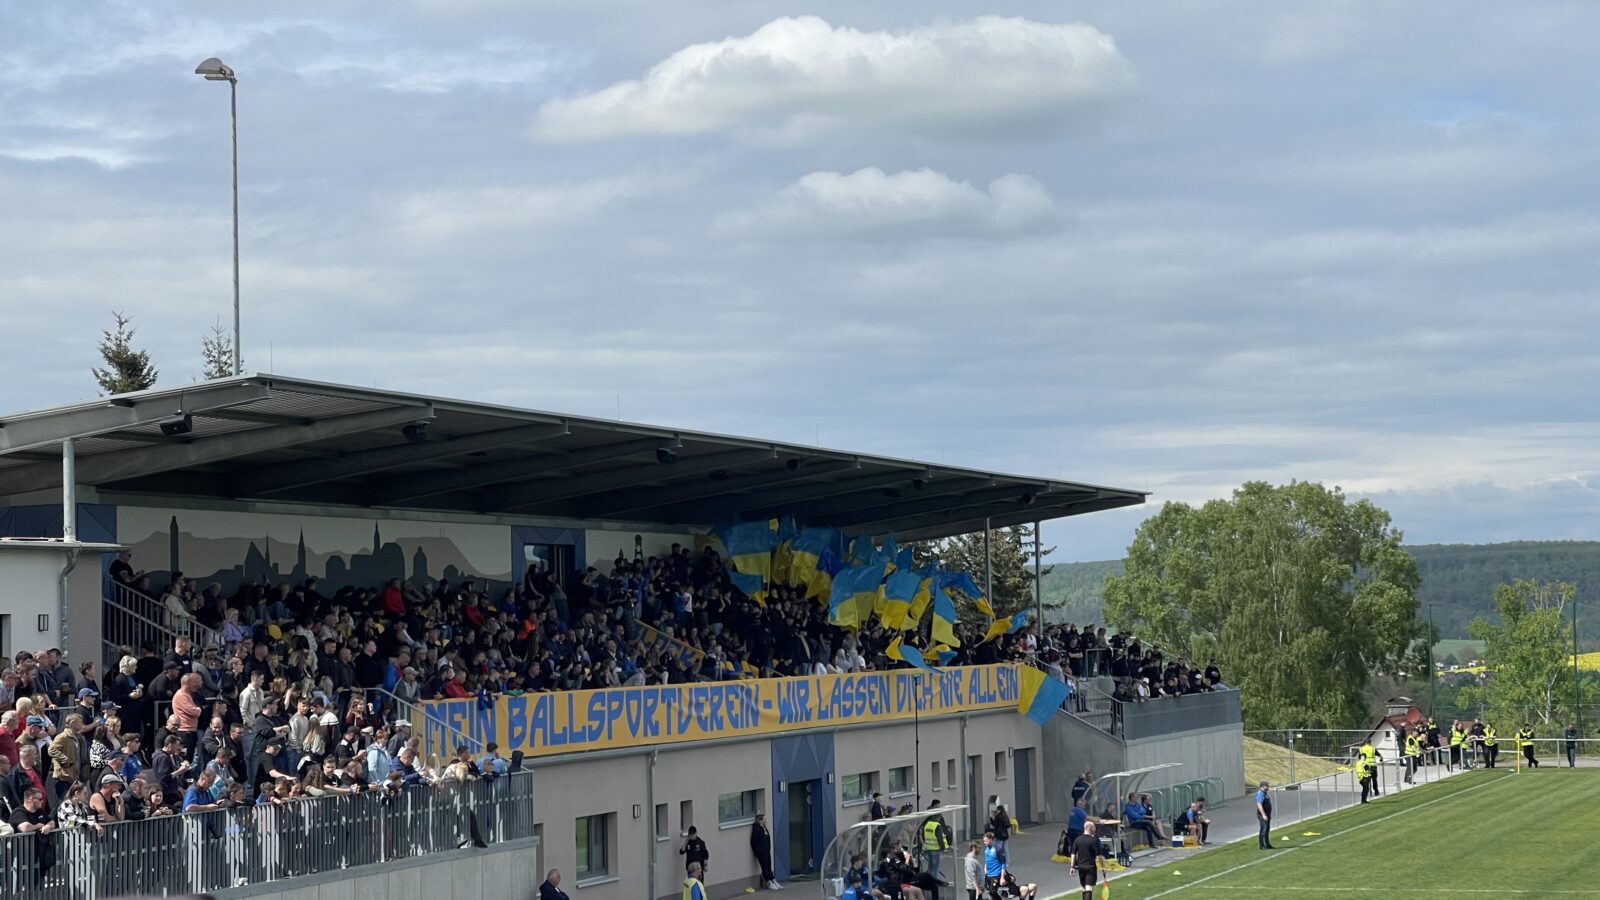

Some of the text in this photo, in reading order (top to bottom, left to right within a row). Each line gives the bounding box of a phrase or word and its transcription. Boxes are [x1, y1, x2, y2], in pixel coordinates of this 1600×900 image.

[425, 701, 497, 757] MEIN
[508, 684, 759, 749] BALLSPORTVEREIN
[777, 680, 812, 724] WIR
[816, 675, 891, 720] LASSEN
[896, 672, 933, 713] DICH
[939, 669, 963, 708] NIE
